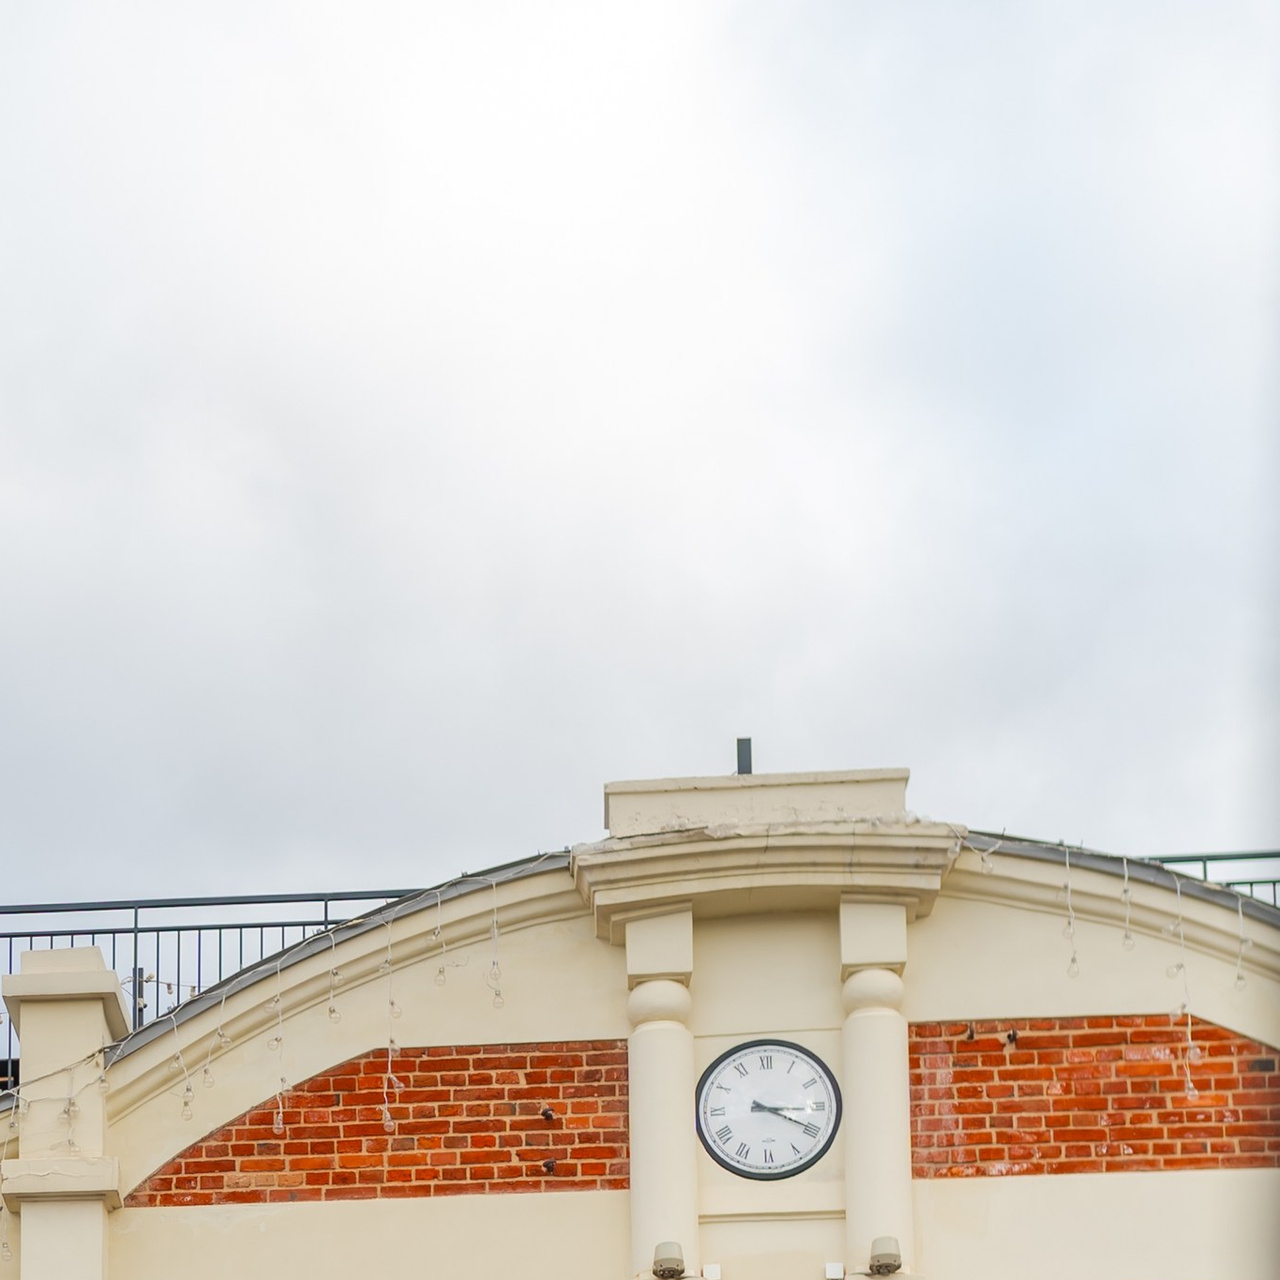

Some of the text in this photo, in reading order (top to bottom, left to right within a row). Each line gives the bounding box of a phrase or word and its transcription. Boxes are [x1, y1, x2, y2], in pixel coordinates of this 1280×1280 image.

[759, 1055, 773, 1070] XII
[734, 1062, 748, 1078] XI
[716, 1082, 731, 1094] X
[802, 1077, 817, 1089] II
[710, 1106, 726, 1117] IX
[715, 1125, 733, 1144] VIII
[736, 1142, 750, 1159] VII
[764, 1149, 774, 1163] VI
